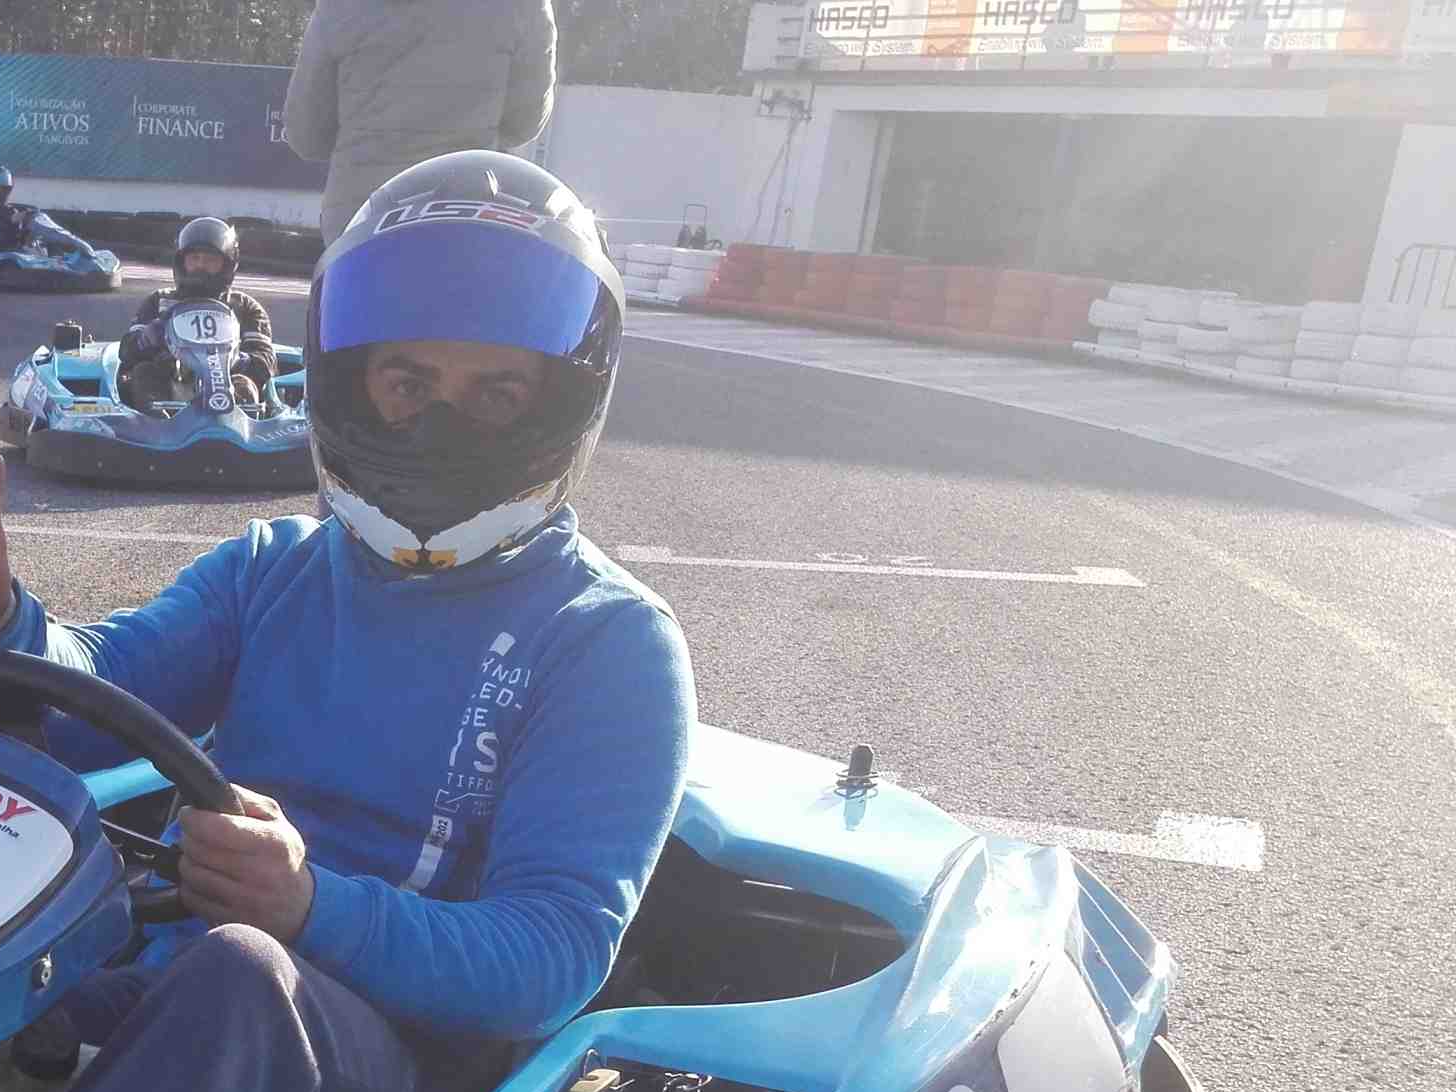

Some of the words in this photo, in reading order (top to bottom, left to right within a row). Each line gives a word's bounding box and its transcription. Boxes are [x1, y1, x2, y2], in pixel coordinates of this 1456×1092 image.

[808, 5, 890, 33] HASCO
[983, 0, 1080, 26] HASCO
[138, 103, 196, 116] CORPORATE
[15, 112, 90, 132] ATIVOS
[138, 117, 225, 139] FINANCE
[191, 315, 217, 338] 19
